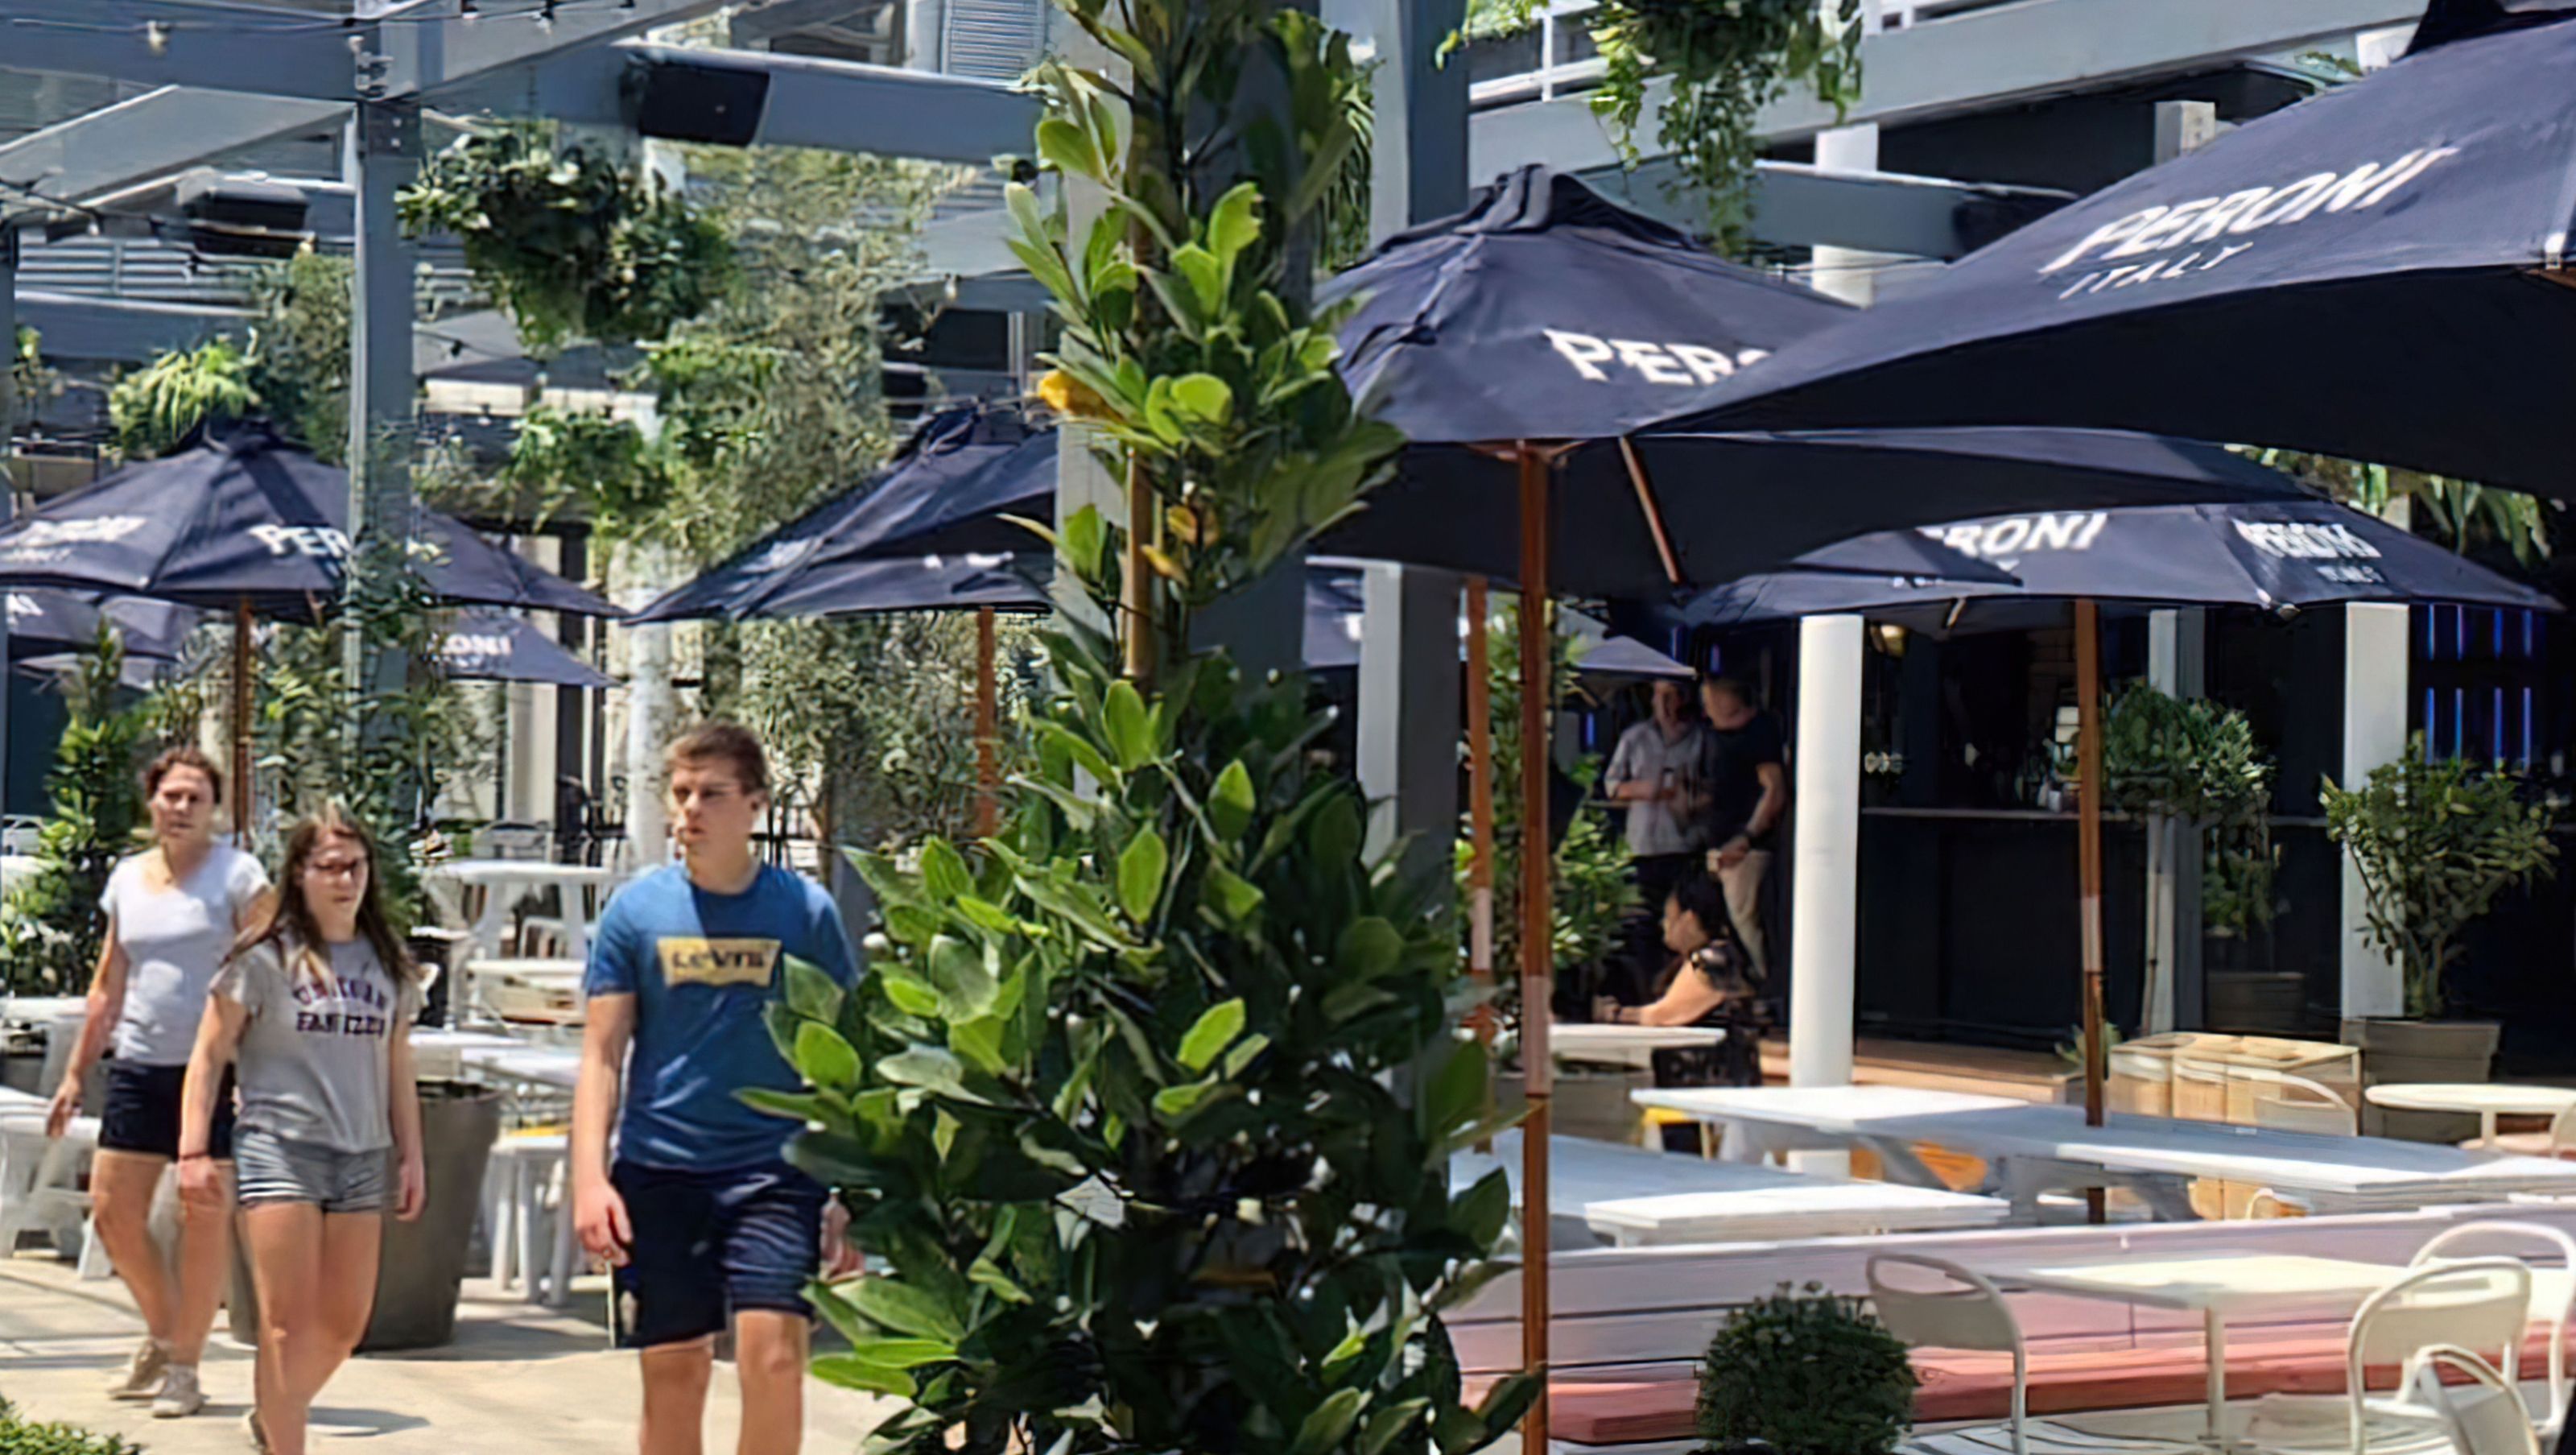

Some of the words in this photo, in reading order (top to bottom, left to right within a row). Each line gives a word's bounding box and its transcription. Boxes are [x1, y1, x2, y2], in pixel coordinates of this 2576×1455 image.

[2037, 147, 2458, 275] PERONI
[2058, 242, 2254, 300] ITALY
[1915, 511, 2107, 558] RONI
